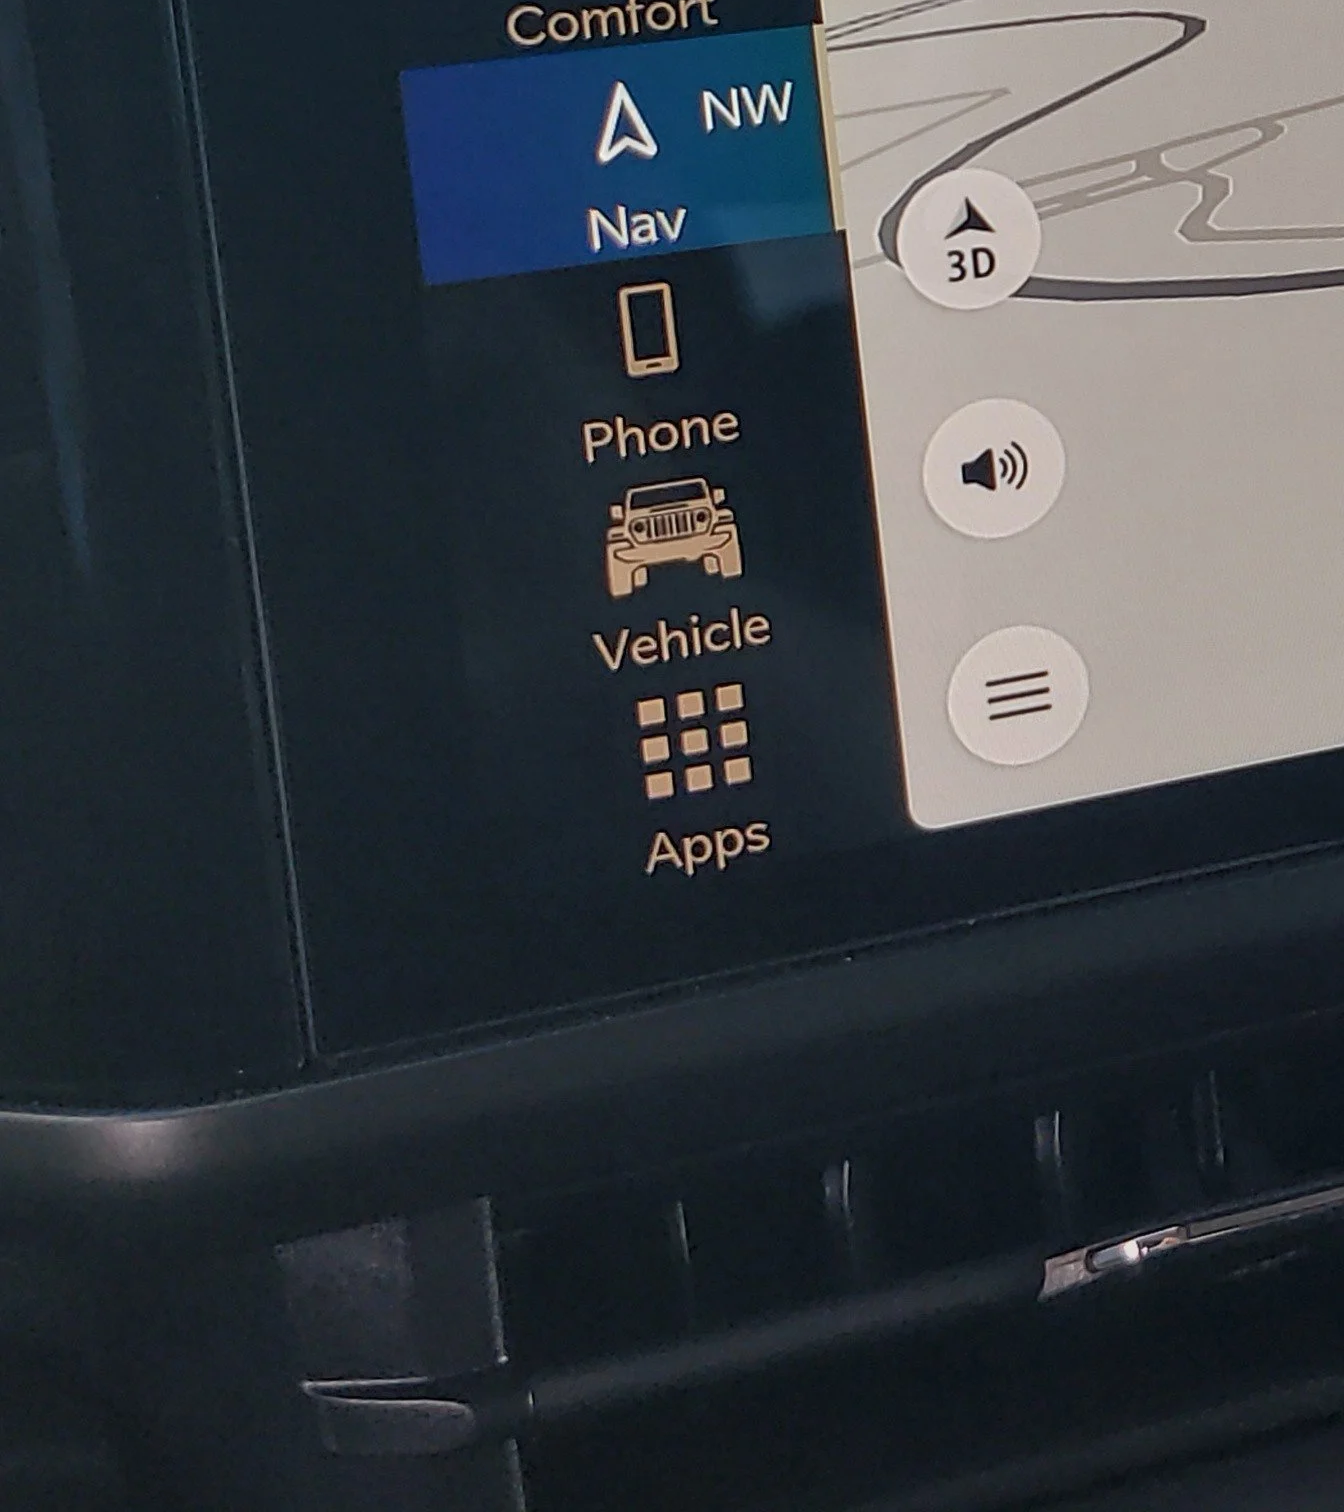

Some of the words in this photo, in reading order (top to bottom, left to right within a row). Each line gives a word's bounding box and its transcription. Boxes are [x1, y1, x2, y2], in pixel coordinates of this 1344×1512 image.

[702, 80, 793, 132] NW
[587, 205, 688, 252] Nav
[947, 249, 997, 283] 3D
[582, 409, 741, 464] Phone
[593, 608, 772, 671] Vehicle
[646, 820, 771, 875] Apps
